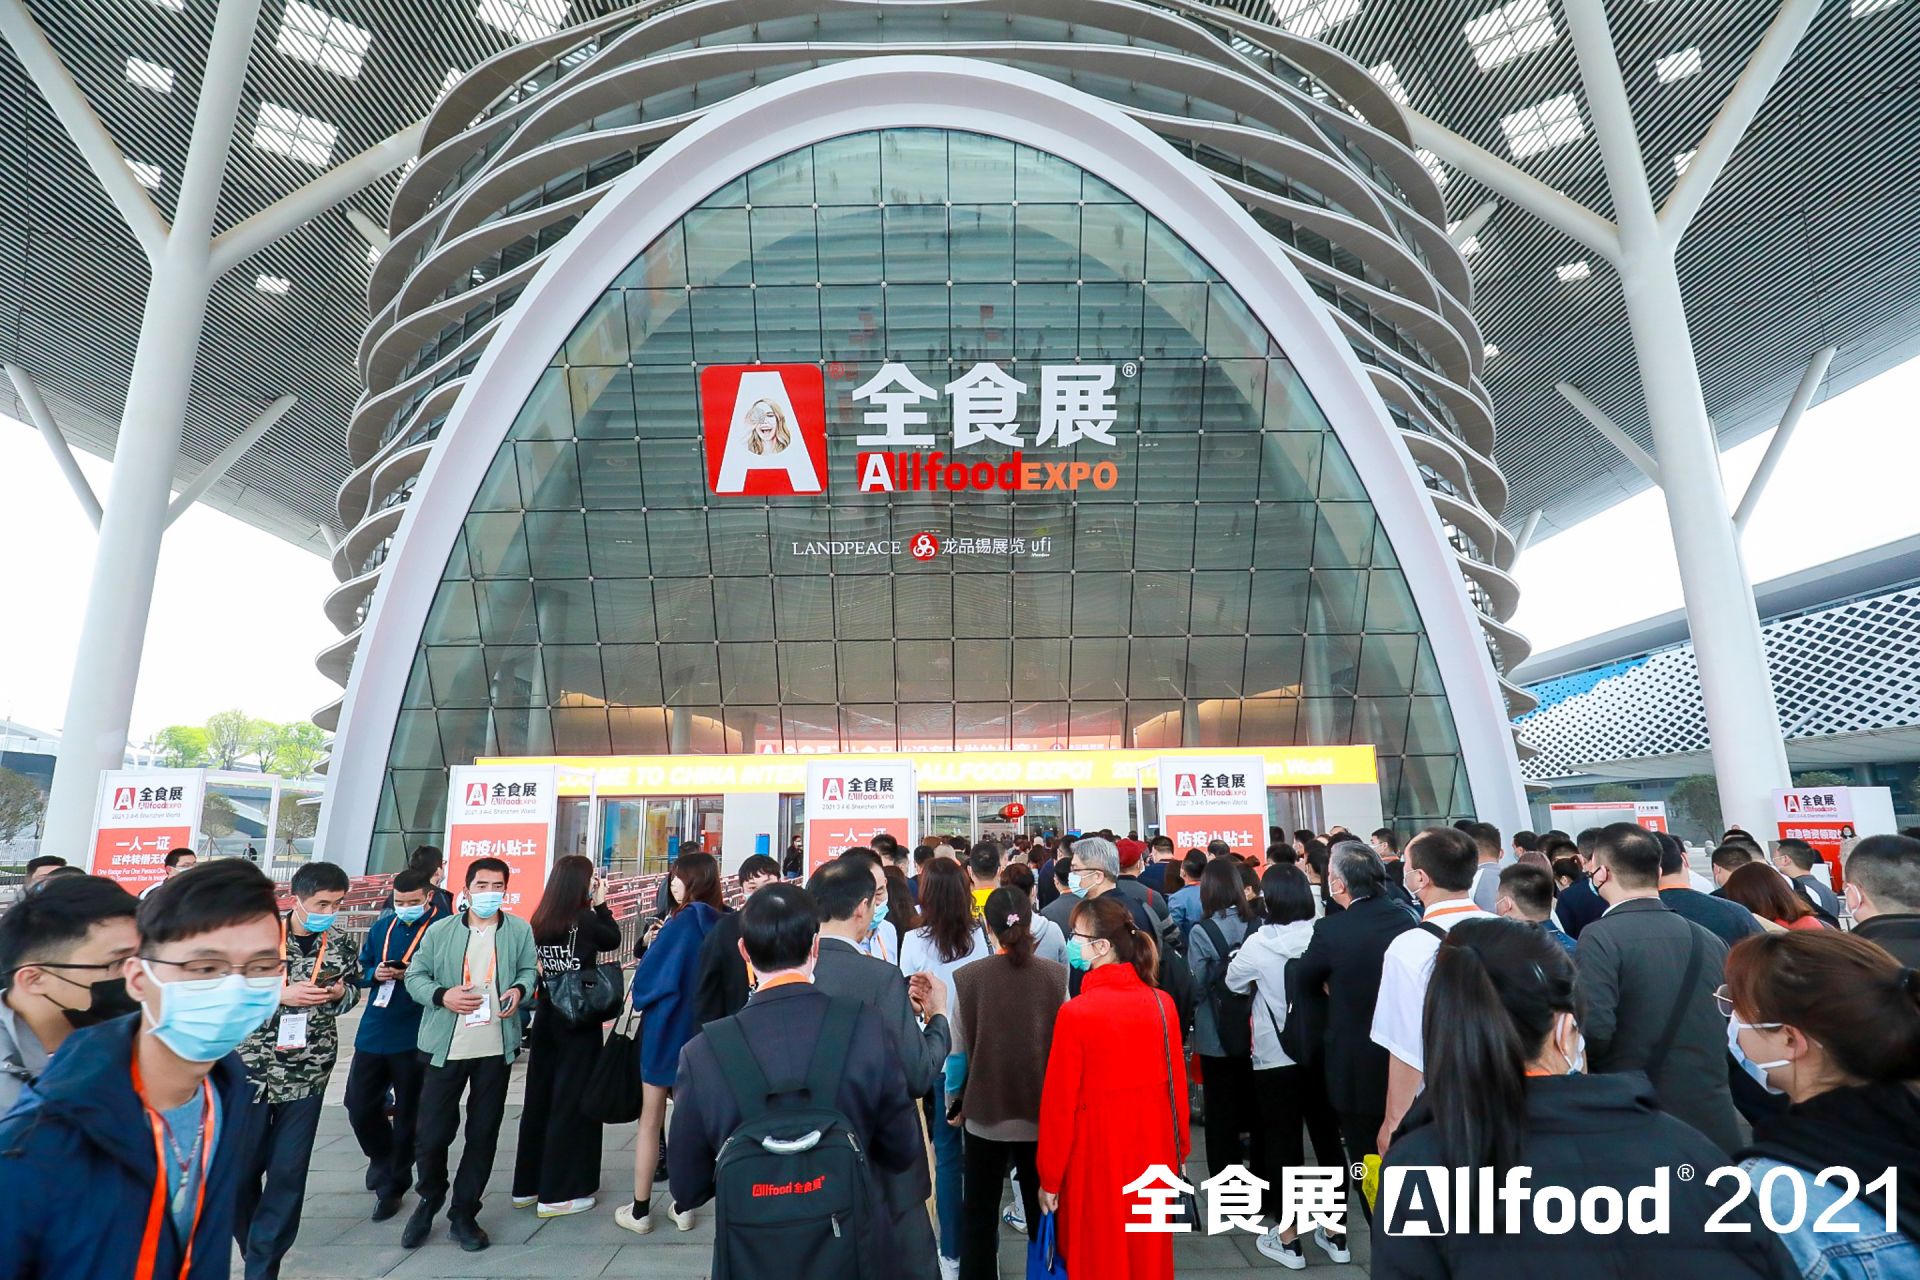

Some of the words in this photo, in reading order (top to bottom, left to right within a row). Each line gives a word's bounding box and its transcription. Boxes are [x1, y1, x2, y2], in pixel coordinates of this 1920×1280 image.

[792, 541, 901, 556] LANDPEACE
[941, 537, 1026, 555] 龙品锡展览
[1031, 536, 1051, 552] ufi
[669, 763, 737, 785] CHINA
[1200, 773, 1246, 788] 全食展
[491, 782, 537, 797] 全食展
[848, 777, 894, 792] 全食展
[139, 786, 183, 801] 全食展
[1802, 794, 1836, 806] 全食展
[115, 836, 171, 851] 一人一证
[1177, 830, 1253, 848] 防疫小贴士
[461, 839, 537, 857] 防疫小贴士
[536, 945, 571, 958] KEITH
[752, 1182, 792, 1197] Allfood
